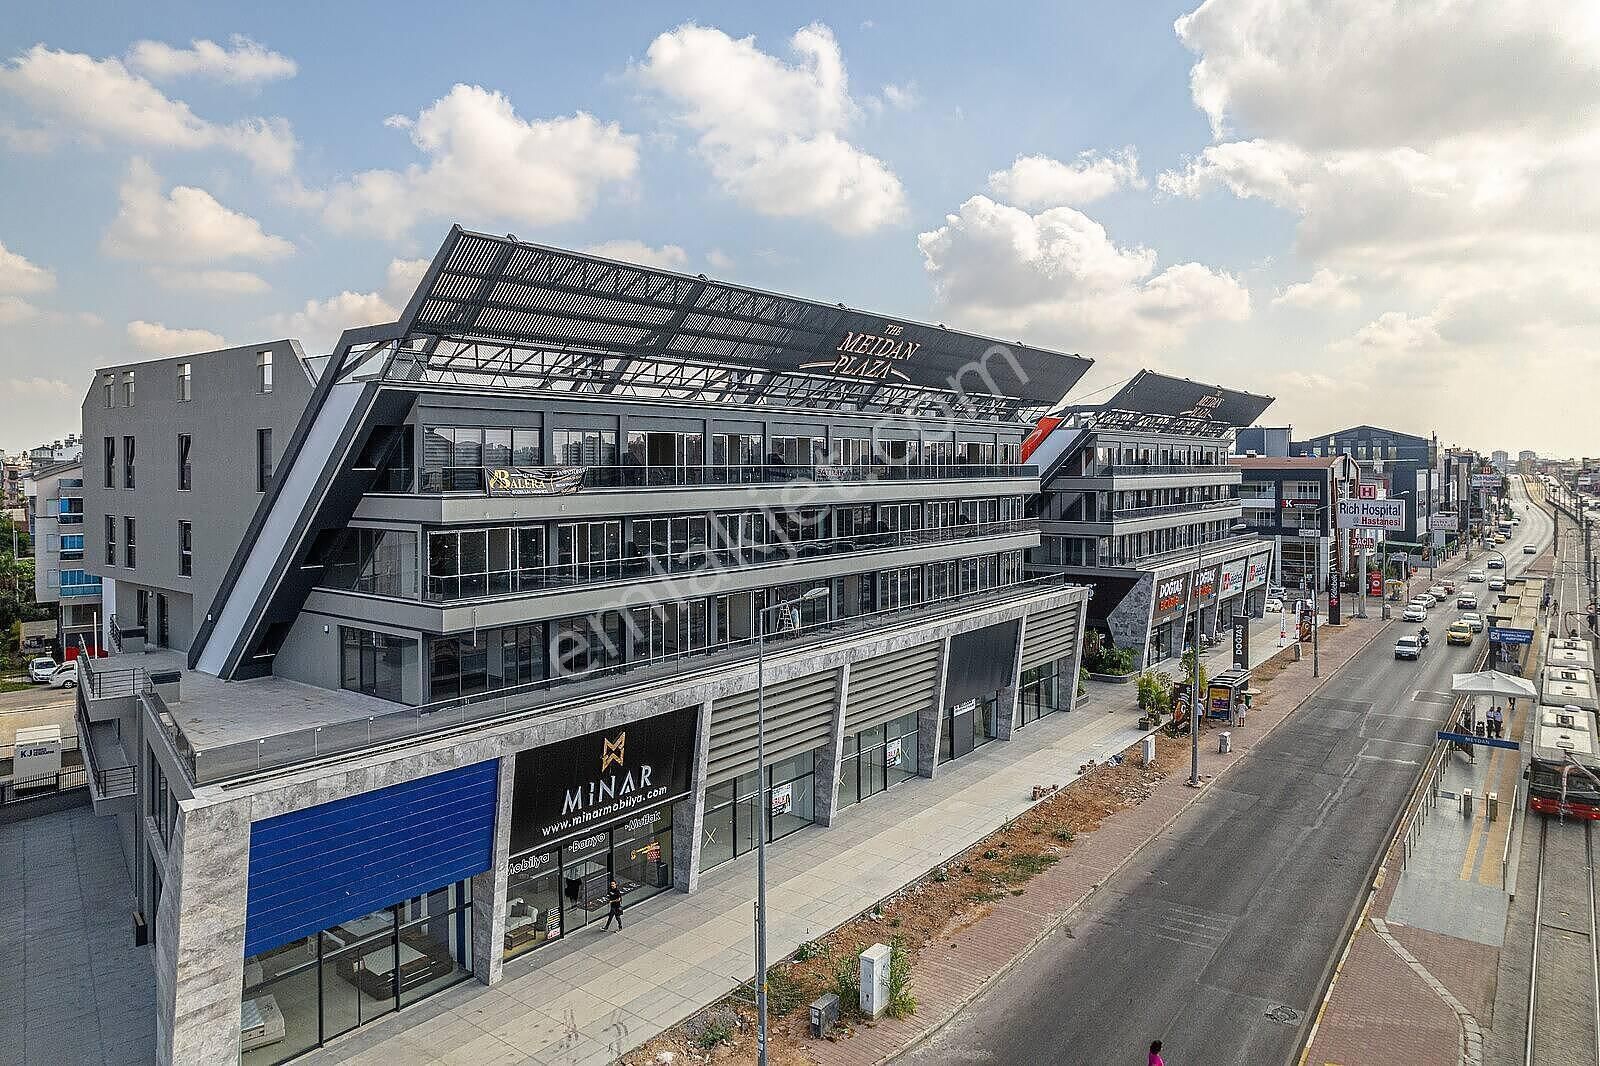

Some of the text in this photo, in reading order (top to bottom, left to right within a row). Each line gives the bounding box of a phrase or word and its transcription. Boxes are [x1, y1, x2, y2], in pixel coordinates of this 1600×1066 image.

[884, 324, 903, 336] THE
[836, 332, 921, 362] MEIDAN
[830, 354, 893, 379] PLAZA
[1339, 503, 1401, 519] Rich Hospital
[1361, 516, 1401, 526] Hastanesi
[541, 786, 668, 837] www.minarmobilya.com
[572, 833, 606, 852] Banyo
